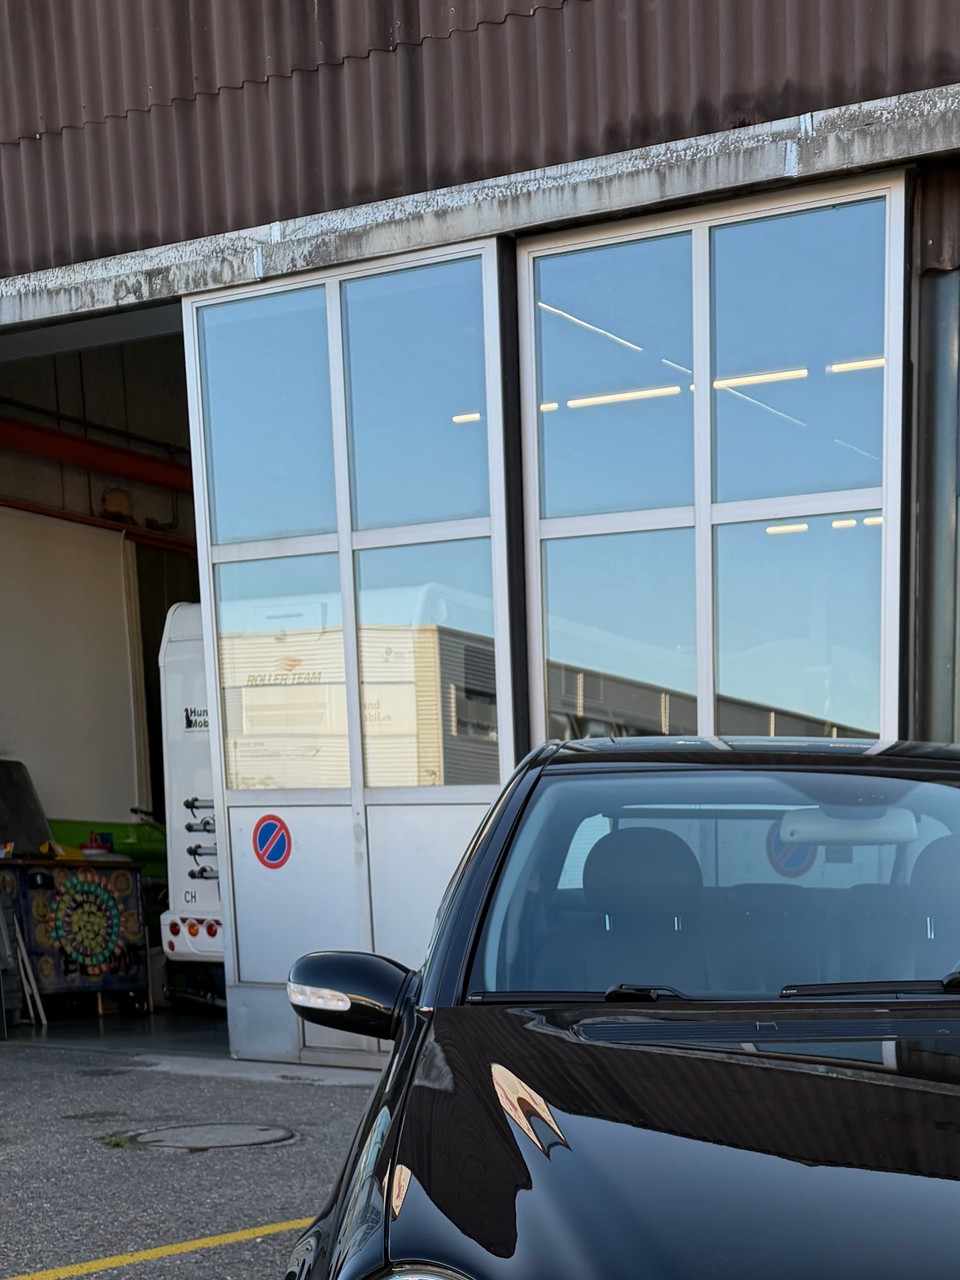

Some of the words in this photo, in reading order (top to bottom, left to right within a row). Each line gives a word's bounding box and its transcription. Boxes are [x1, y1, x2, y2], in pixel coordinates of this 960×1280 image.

[247, 673, 289, 687] ROLLER
[290, 671, 322, 685] TEAM
[184, 890, 197, 904] CH
